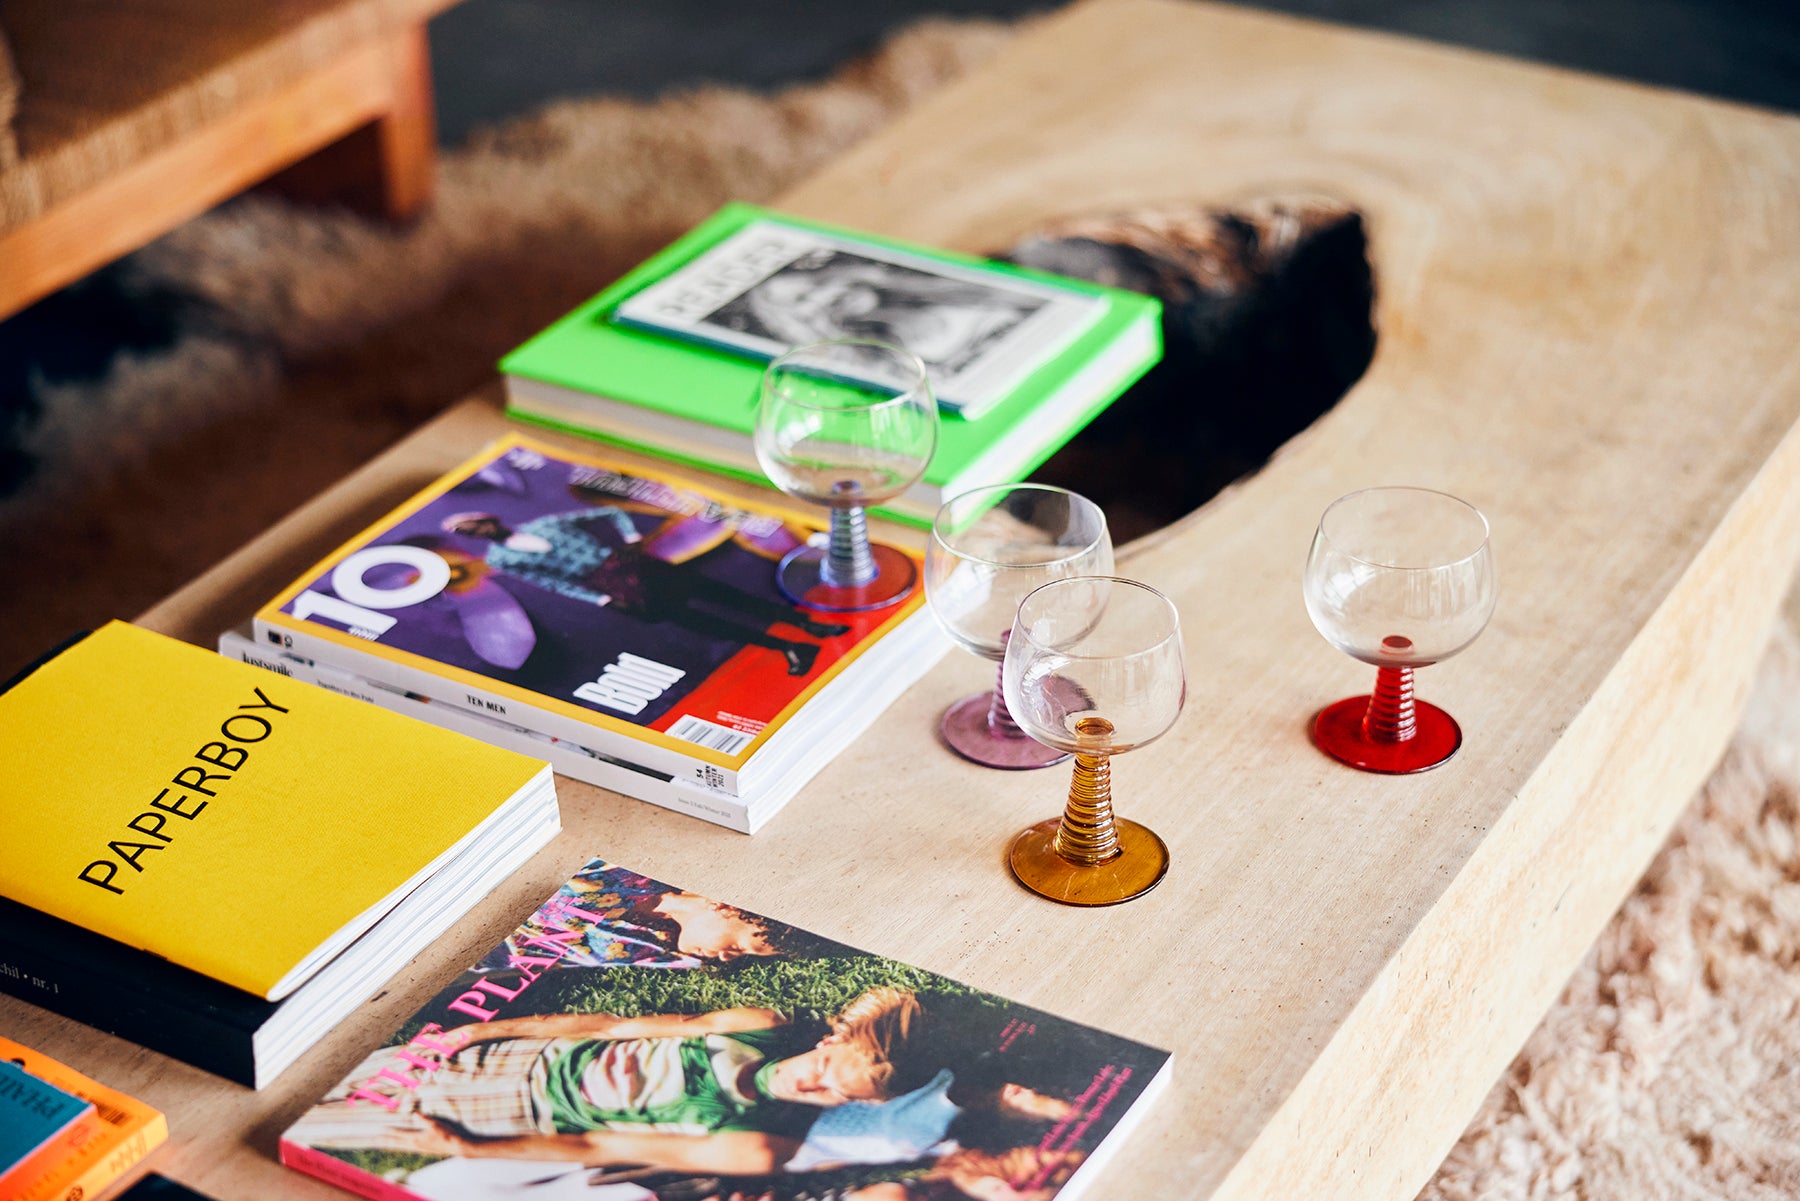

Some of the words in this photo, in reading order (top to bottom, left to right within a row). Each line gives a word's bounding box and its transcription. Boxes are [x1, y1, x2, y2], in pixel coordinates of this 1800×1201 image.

[291, 545, 451, 635] 10
[466, 694, 484, 707] TEN
[486, 701, 506, 714] MEN
[572, 652, 687, 716] Bold
[77, 686, 290, 896] PAPERBOY
[346, 1022, 471, 1112] THE
[448, 897, 607, 1023] PLANT
